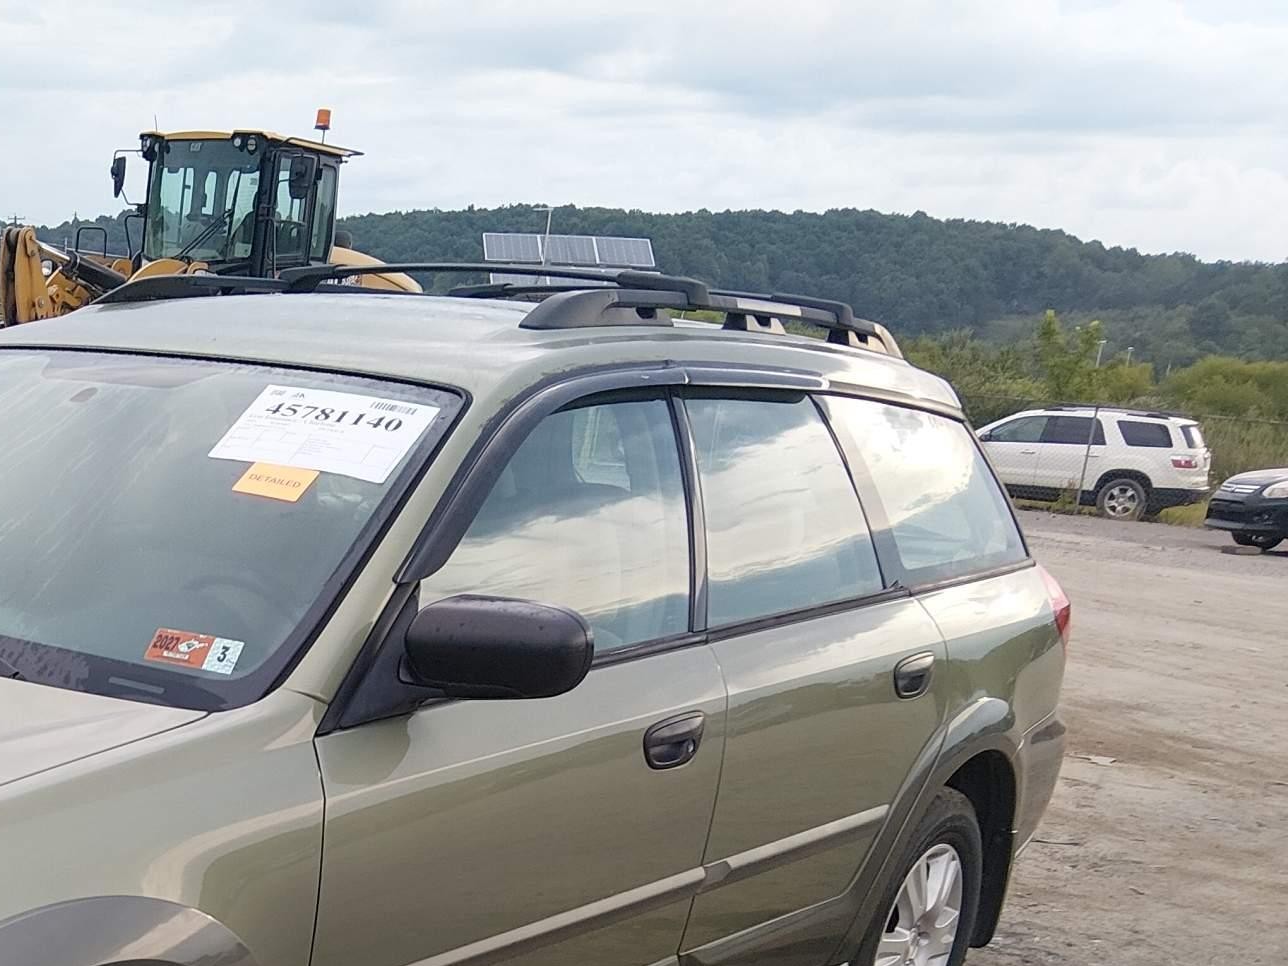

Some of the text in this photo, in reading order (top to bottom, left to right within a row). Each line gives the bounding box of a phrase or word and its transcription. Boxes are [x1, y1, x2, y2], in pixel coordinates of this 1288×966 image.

[265, 402, 402, 432] 45781140
[248, 473, 302, 489] DETAILED
[152, 634, 181, 652] 2027
[217, 645, 231, 662] 3
